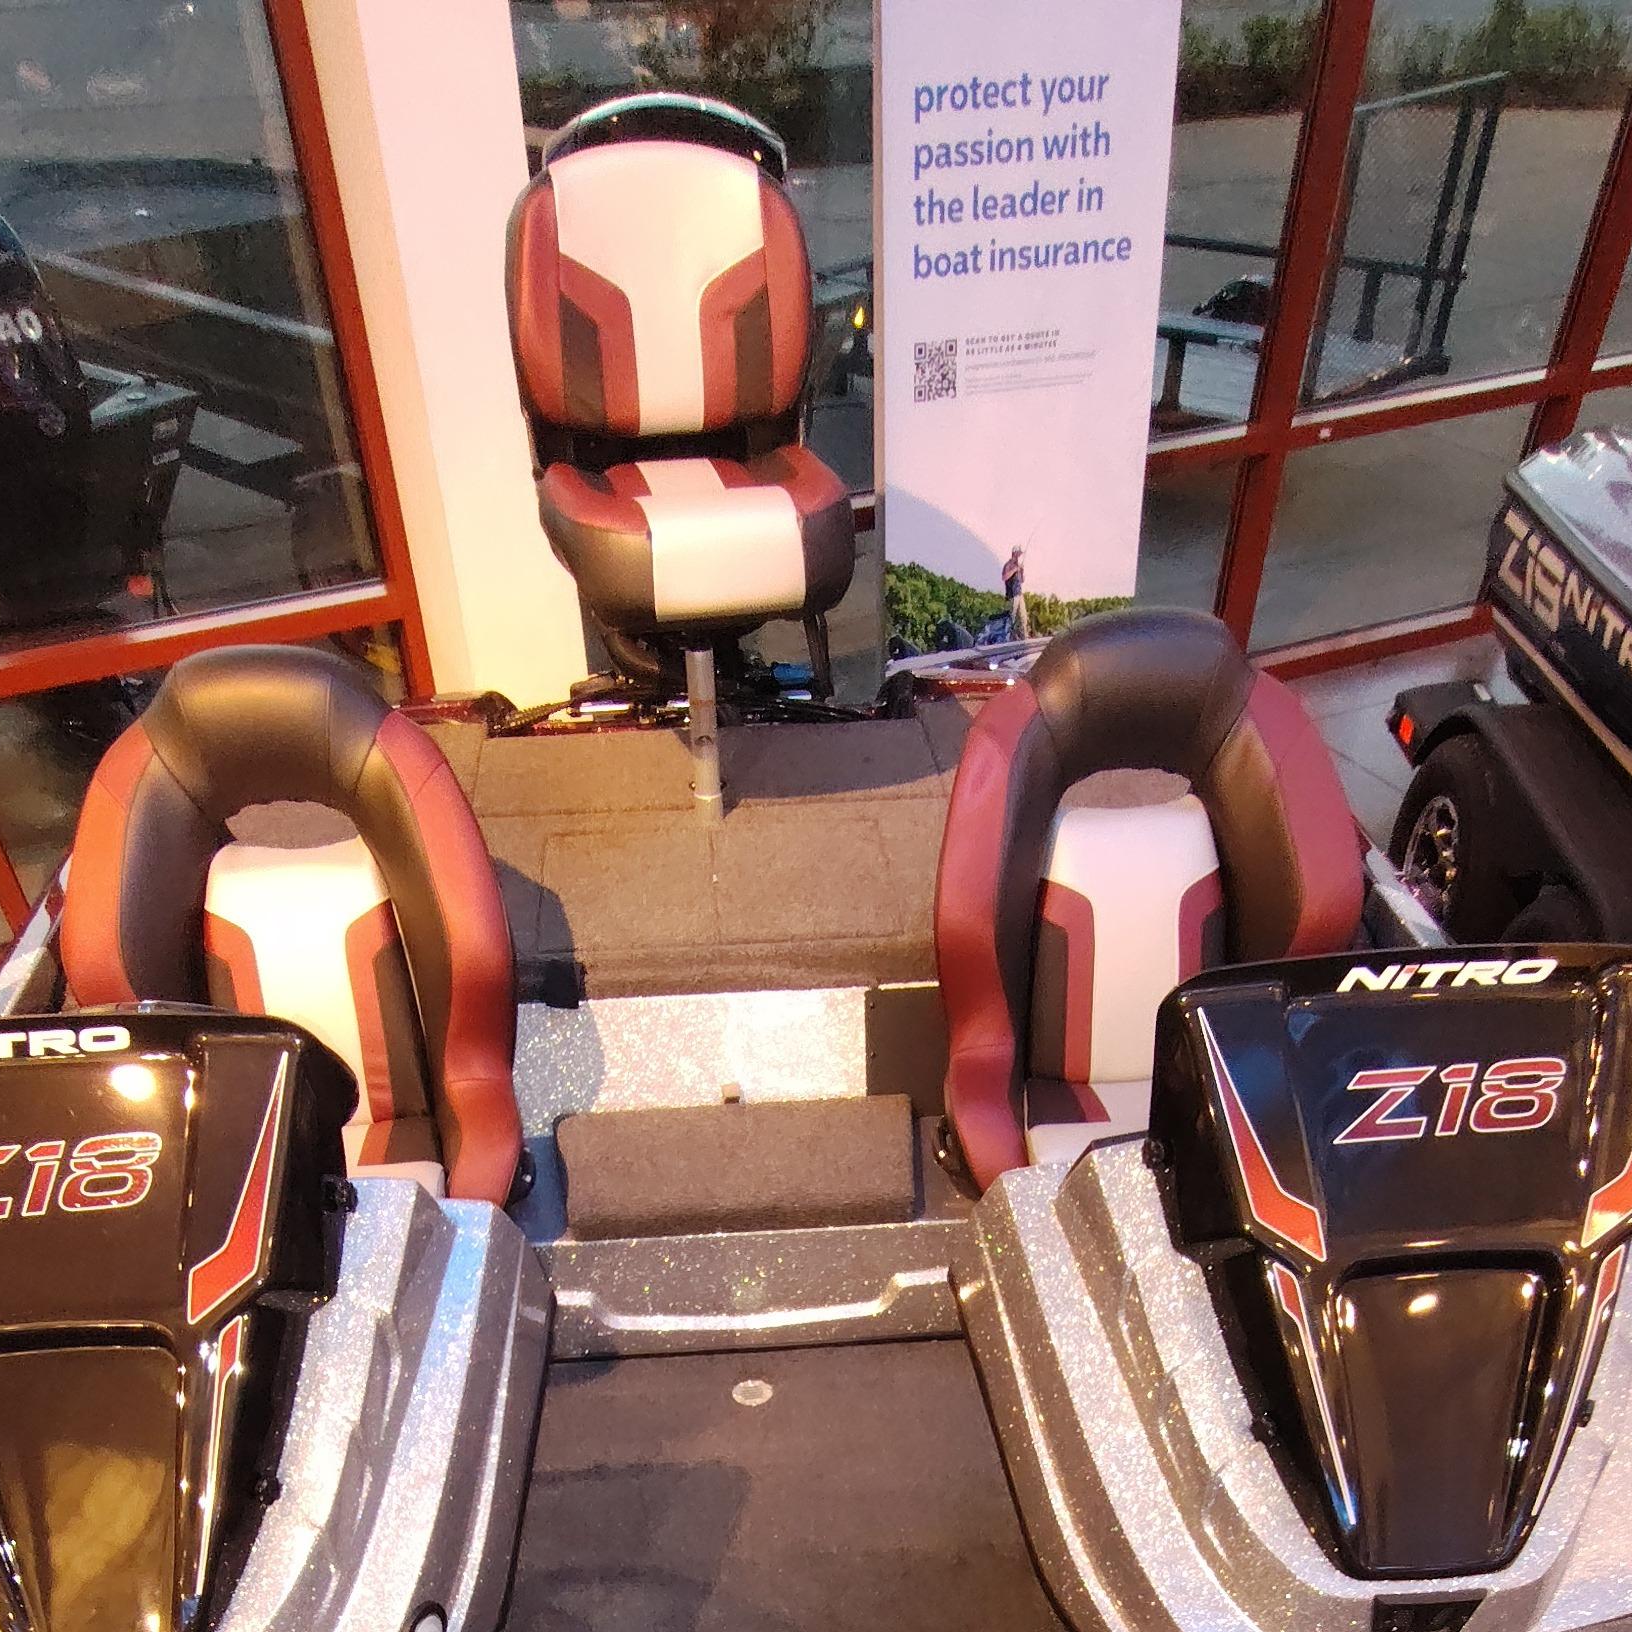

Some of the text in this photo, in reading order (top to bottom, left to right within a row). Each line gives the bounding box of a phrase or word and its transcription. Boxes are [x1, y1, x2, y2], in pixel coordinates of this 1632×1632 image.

[914, 72, 1110, 124] protect your
[914, 121, 1111, 180] passion with
[913, 177, 1104, 226] the leader in
[914, 236, 1132, 279] boat insurance
[1332, 1056, 1568, 1145] Z18
